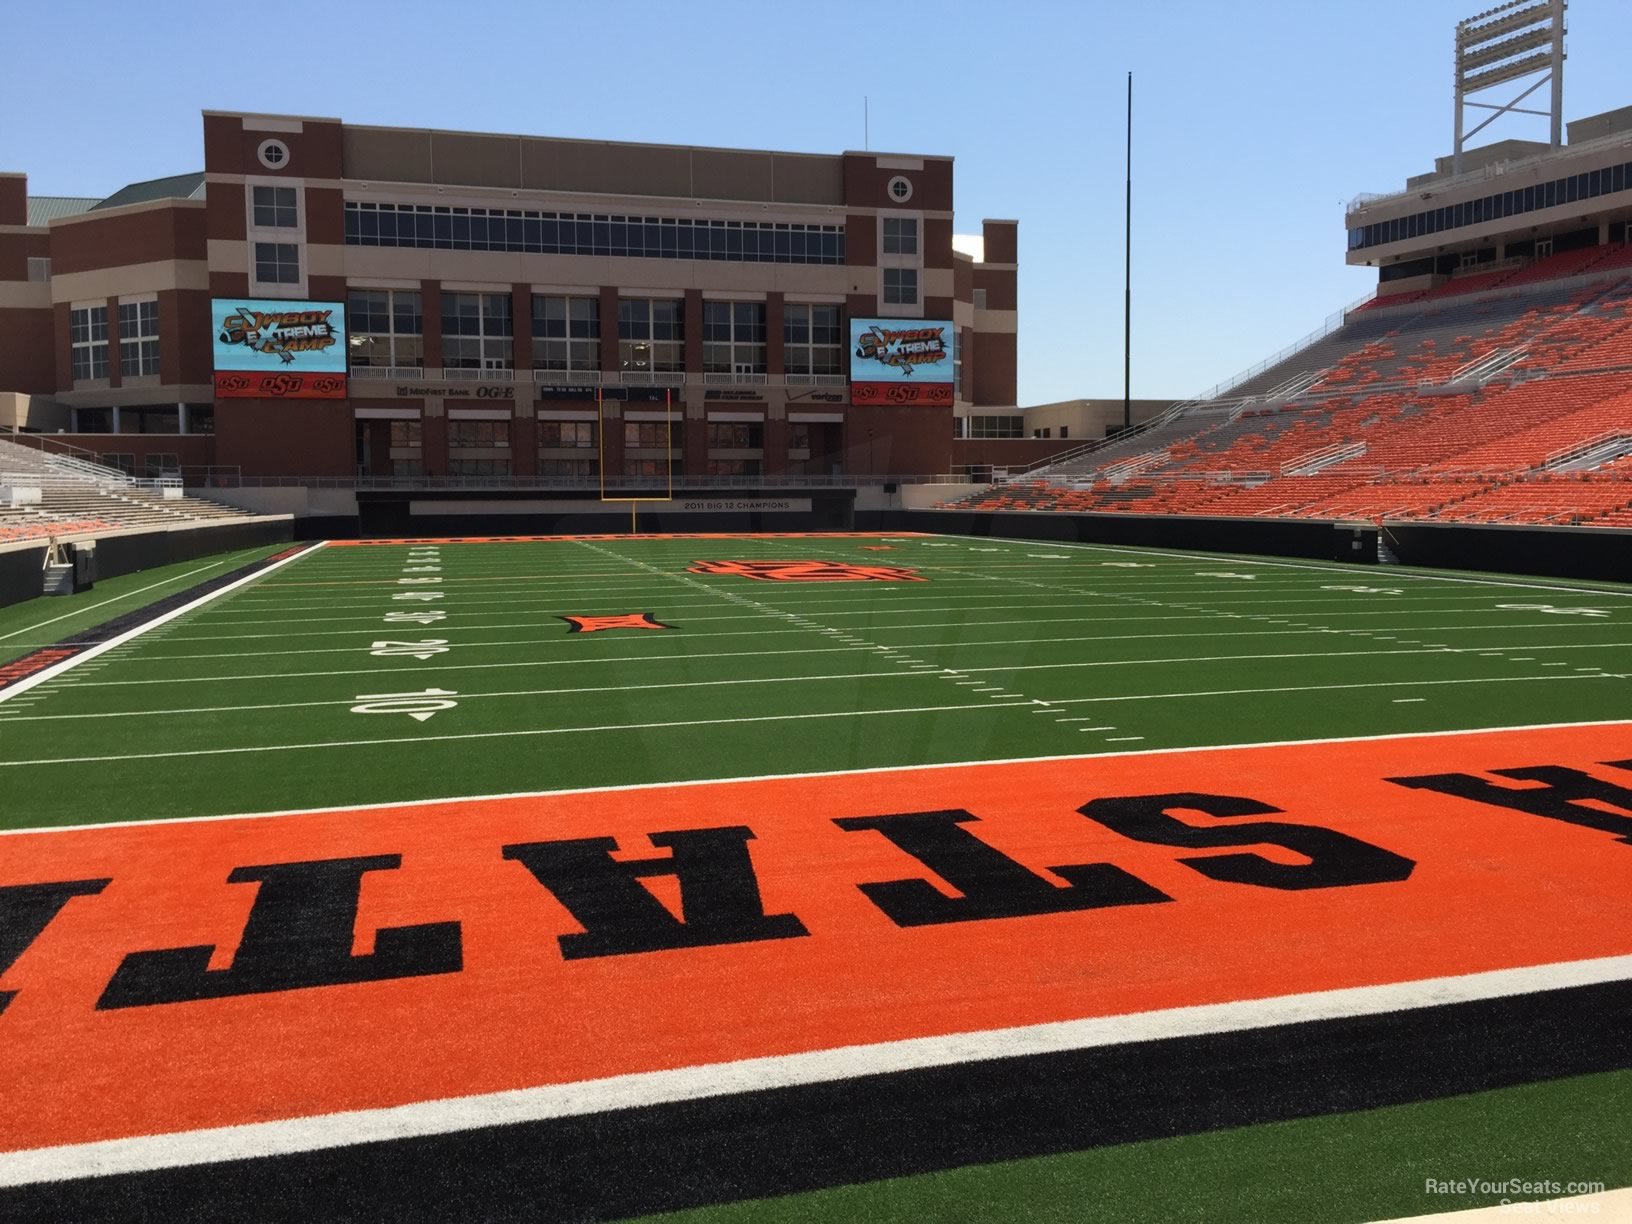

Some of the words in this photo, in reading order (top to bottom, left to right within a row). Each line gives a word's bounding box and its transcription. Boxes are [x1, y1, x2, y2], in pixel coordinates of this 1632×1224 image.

[261, 338, 336, 354] CAMP
[887, 352, 946, 367] CAMP
[219, 376, 250, 391] OSU
[259, 374, 303, 396] OSU
[312, 377, 344, 393] OSU
[887, 384, 920, 403] OSU
[811, 393, 843, 402] verizon
[369, 639, 450, 656] 20
[350, 687, 458, 713] 10
